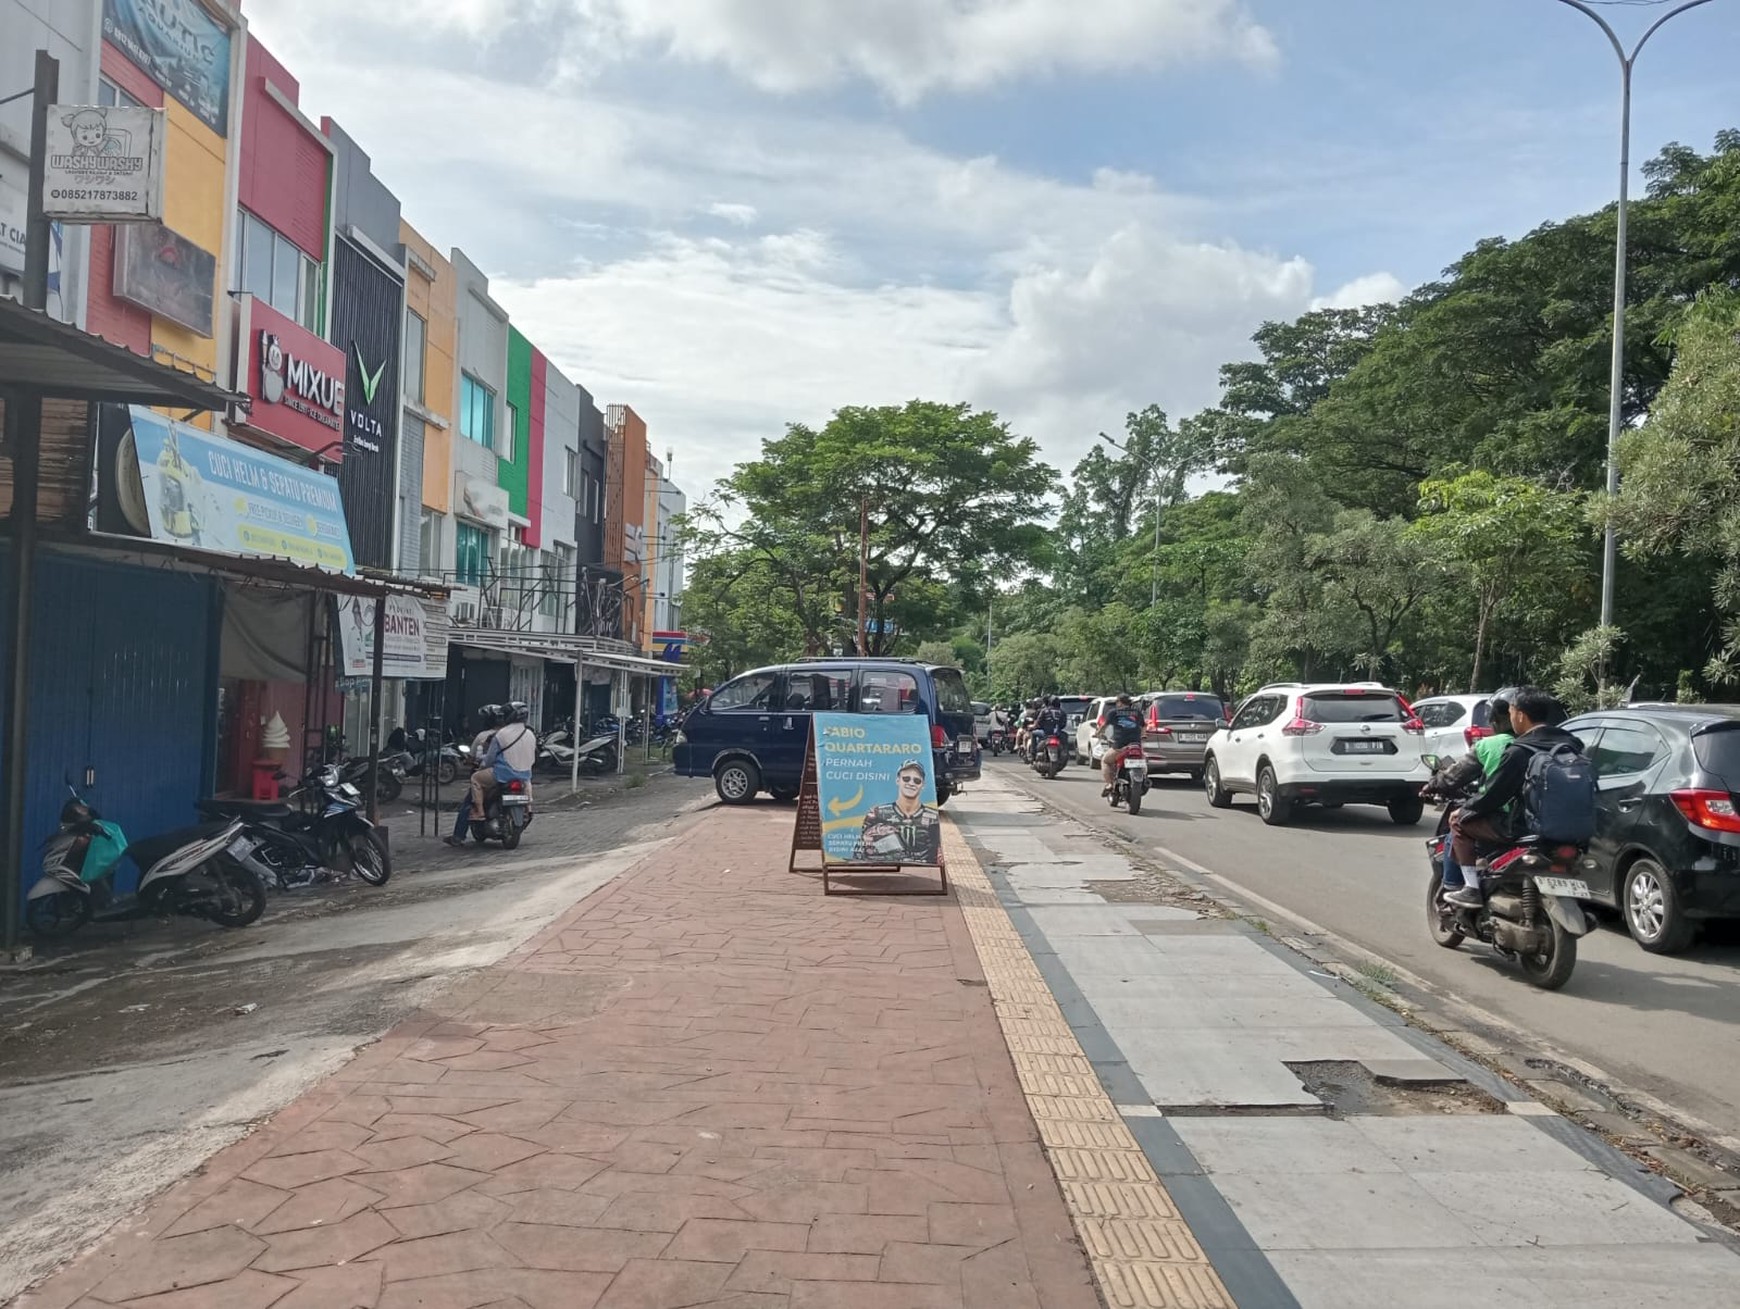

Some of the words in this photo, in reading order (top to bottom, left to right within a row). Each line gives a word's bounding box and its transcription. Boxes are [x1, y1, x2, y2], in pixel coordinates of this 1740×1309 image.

[61, 189, 138, 201] 085217873882
[286, 352, 345, 416] MIXUE
[350, 409, 383, 438] VOLTA
[208, 450, 233, 479] CUCI
[233, 459, 260, 488] HELM
[268, 471, 301, 502] SEPATU
[301, 481, 339, 514] PREMIUM
[384, 613, 420, 637] BANTEN
[823, 726, 866, 739] FABIO
[823, 742, 923, 755] QUARTARARO
[825, 757, 873, 769] PERNAH
[825, 770, 854, 781] CUCI
[855, 771, 890, 782] DISINI
